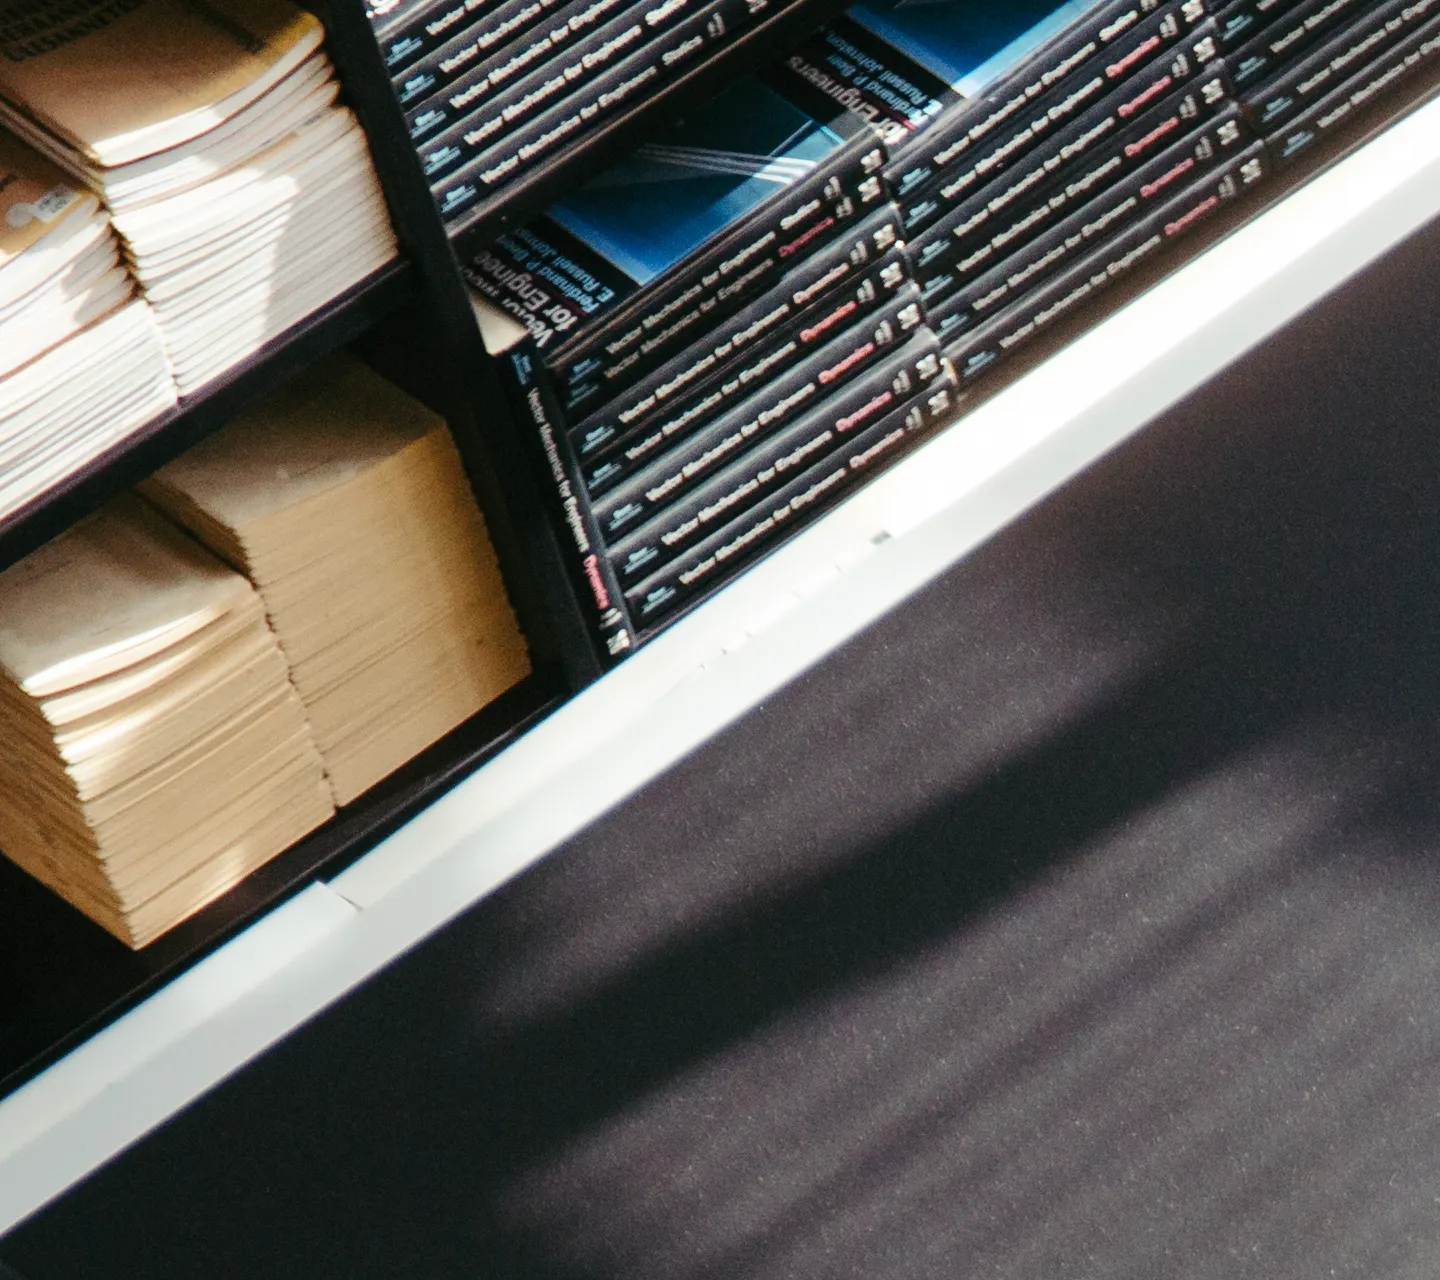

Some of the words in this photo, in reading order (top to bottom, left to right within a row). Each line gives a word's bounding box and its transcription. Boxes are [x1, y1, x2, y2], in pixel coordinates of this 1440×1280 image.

[450, 79, 489, 108] Vector
[489, 38, 551, 84] Mechanics
[464, 116, 503, 145] Vector
[502, 76, 566, 122] Mechanics
[564, 62, 583, 81] for
[582, 25, 641, 69] Engineers
[480, 155, 519, 184] Vector
[518, 116, 581, 160] Mechanics
[580, 103, 598, 120] for
[598, 66, 656, 107] Engineers
[662, 36, 703, 66] Statics
[933, 136, 970, 165] Vector
[969, 94, 1026, 140] Mechanics
[1025, 82, 1042, 98] for
[1041, 42, 1096, 86] Engineers
[1099, 10, 1138, 42] Statics
[940, 170, 976, 198] Vector
[975, 128, 1033, 174] Mechanics
[1031, 116, 1049, 133] for
[1048, 77, 1103, 121] Engineers
[1105, 36, 1160, 78] Dynamics
[646, 472, 683, 501] Vector
[682, 433, 743, 477] Mechanics
[741, 421, 759, 438] for
[758, 383, 815, 425] Engineers
[818, 341, 874, 384] Dynamics
[661, 518, 699, 545] Vector
[698, 479, 759, 523] Mechanics
[757, 467, 775, 483] for
[774, 431, 832, 472] Engineers
[836, 392, 892, 432] Dynamics
